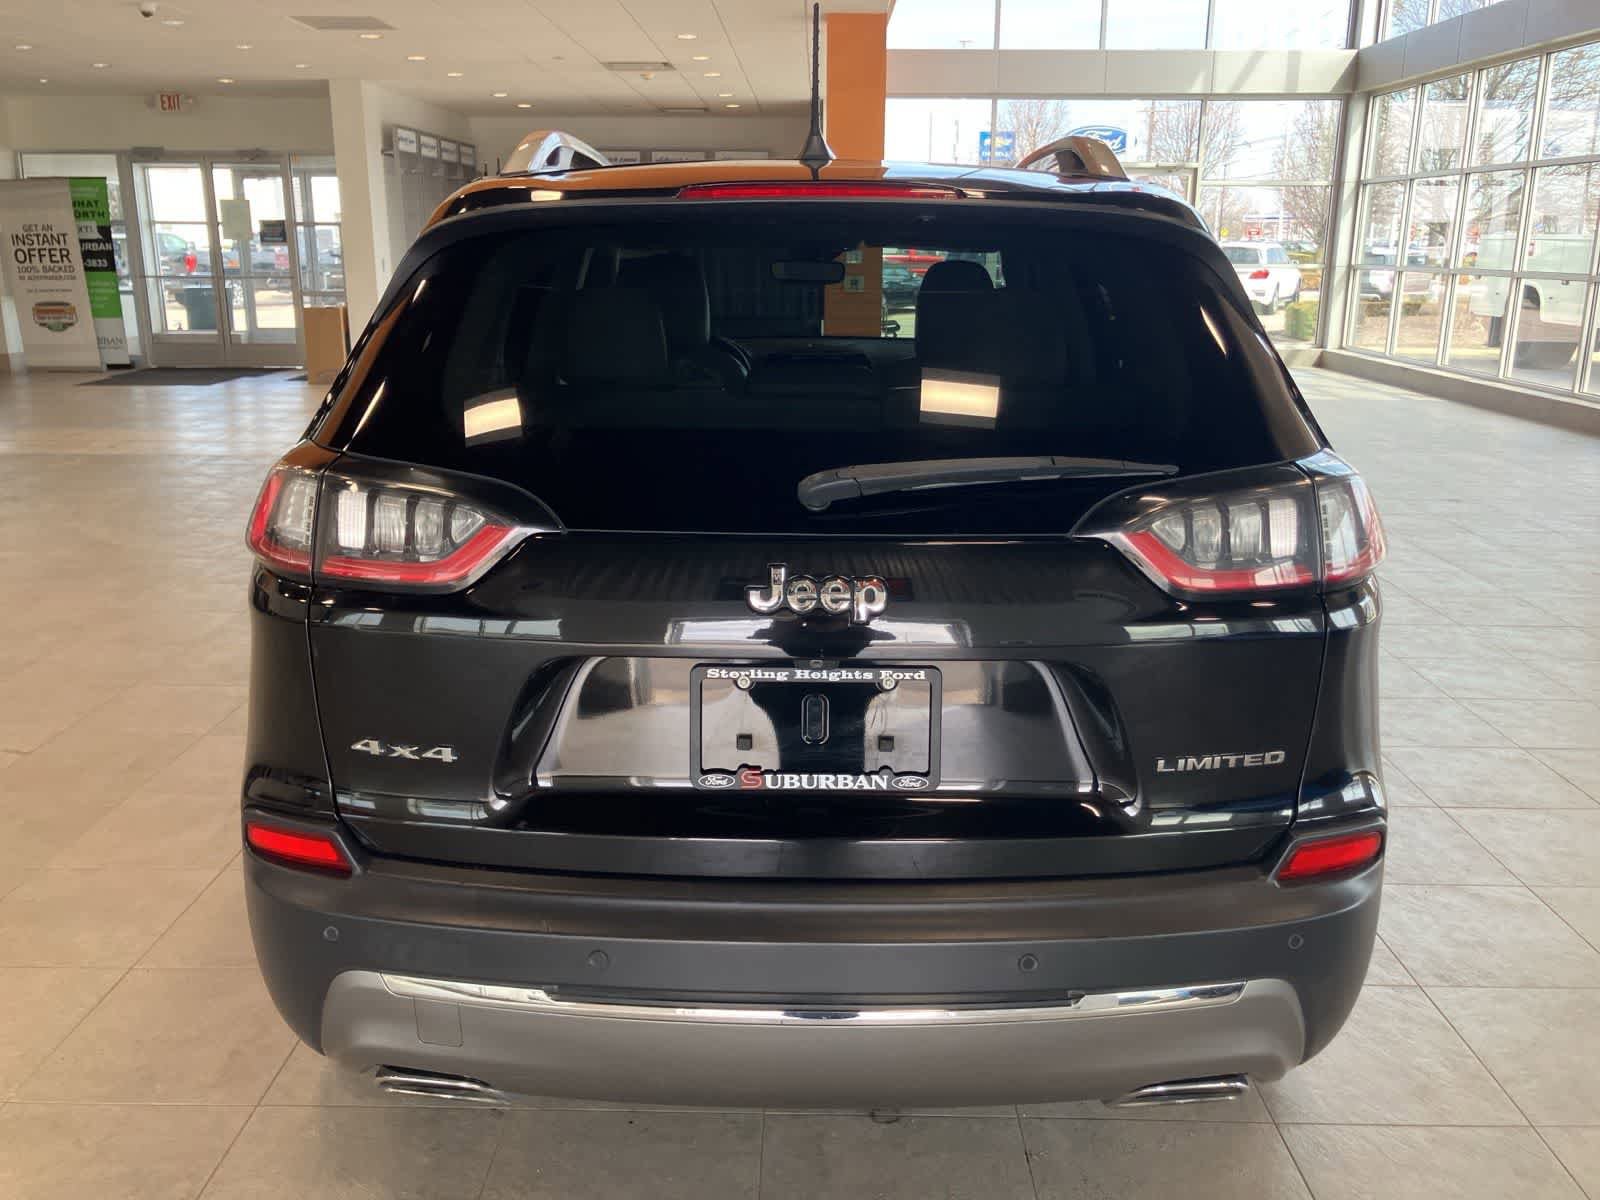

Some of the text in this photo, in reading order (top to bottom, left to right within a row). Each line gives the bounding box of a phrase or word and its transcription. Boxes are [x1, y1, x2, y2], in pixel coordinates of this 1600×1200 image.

[160, 94, 182, 111] EXIT
[22, 224, 53, 232] GET AN
[11, 233, 67, 246] INSTANT
[14, 248, 72, 264] OFFER
[42, 265, 75, 273] BACKED
[746, 563, 888, 624] Jeep
[706, 669, 926, 682] Sterling Heights Ford
[1156, 750, 1286, 773] LIMITED
[702, 770, 925, 790] Ford SUBURBAN Ford
